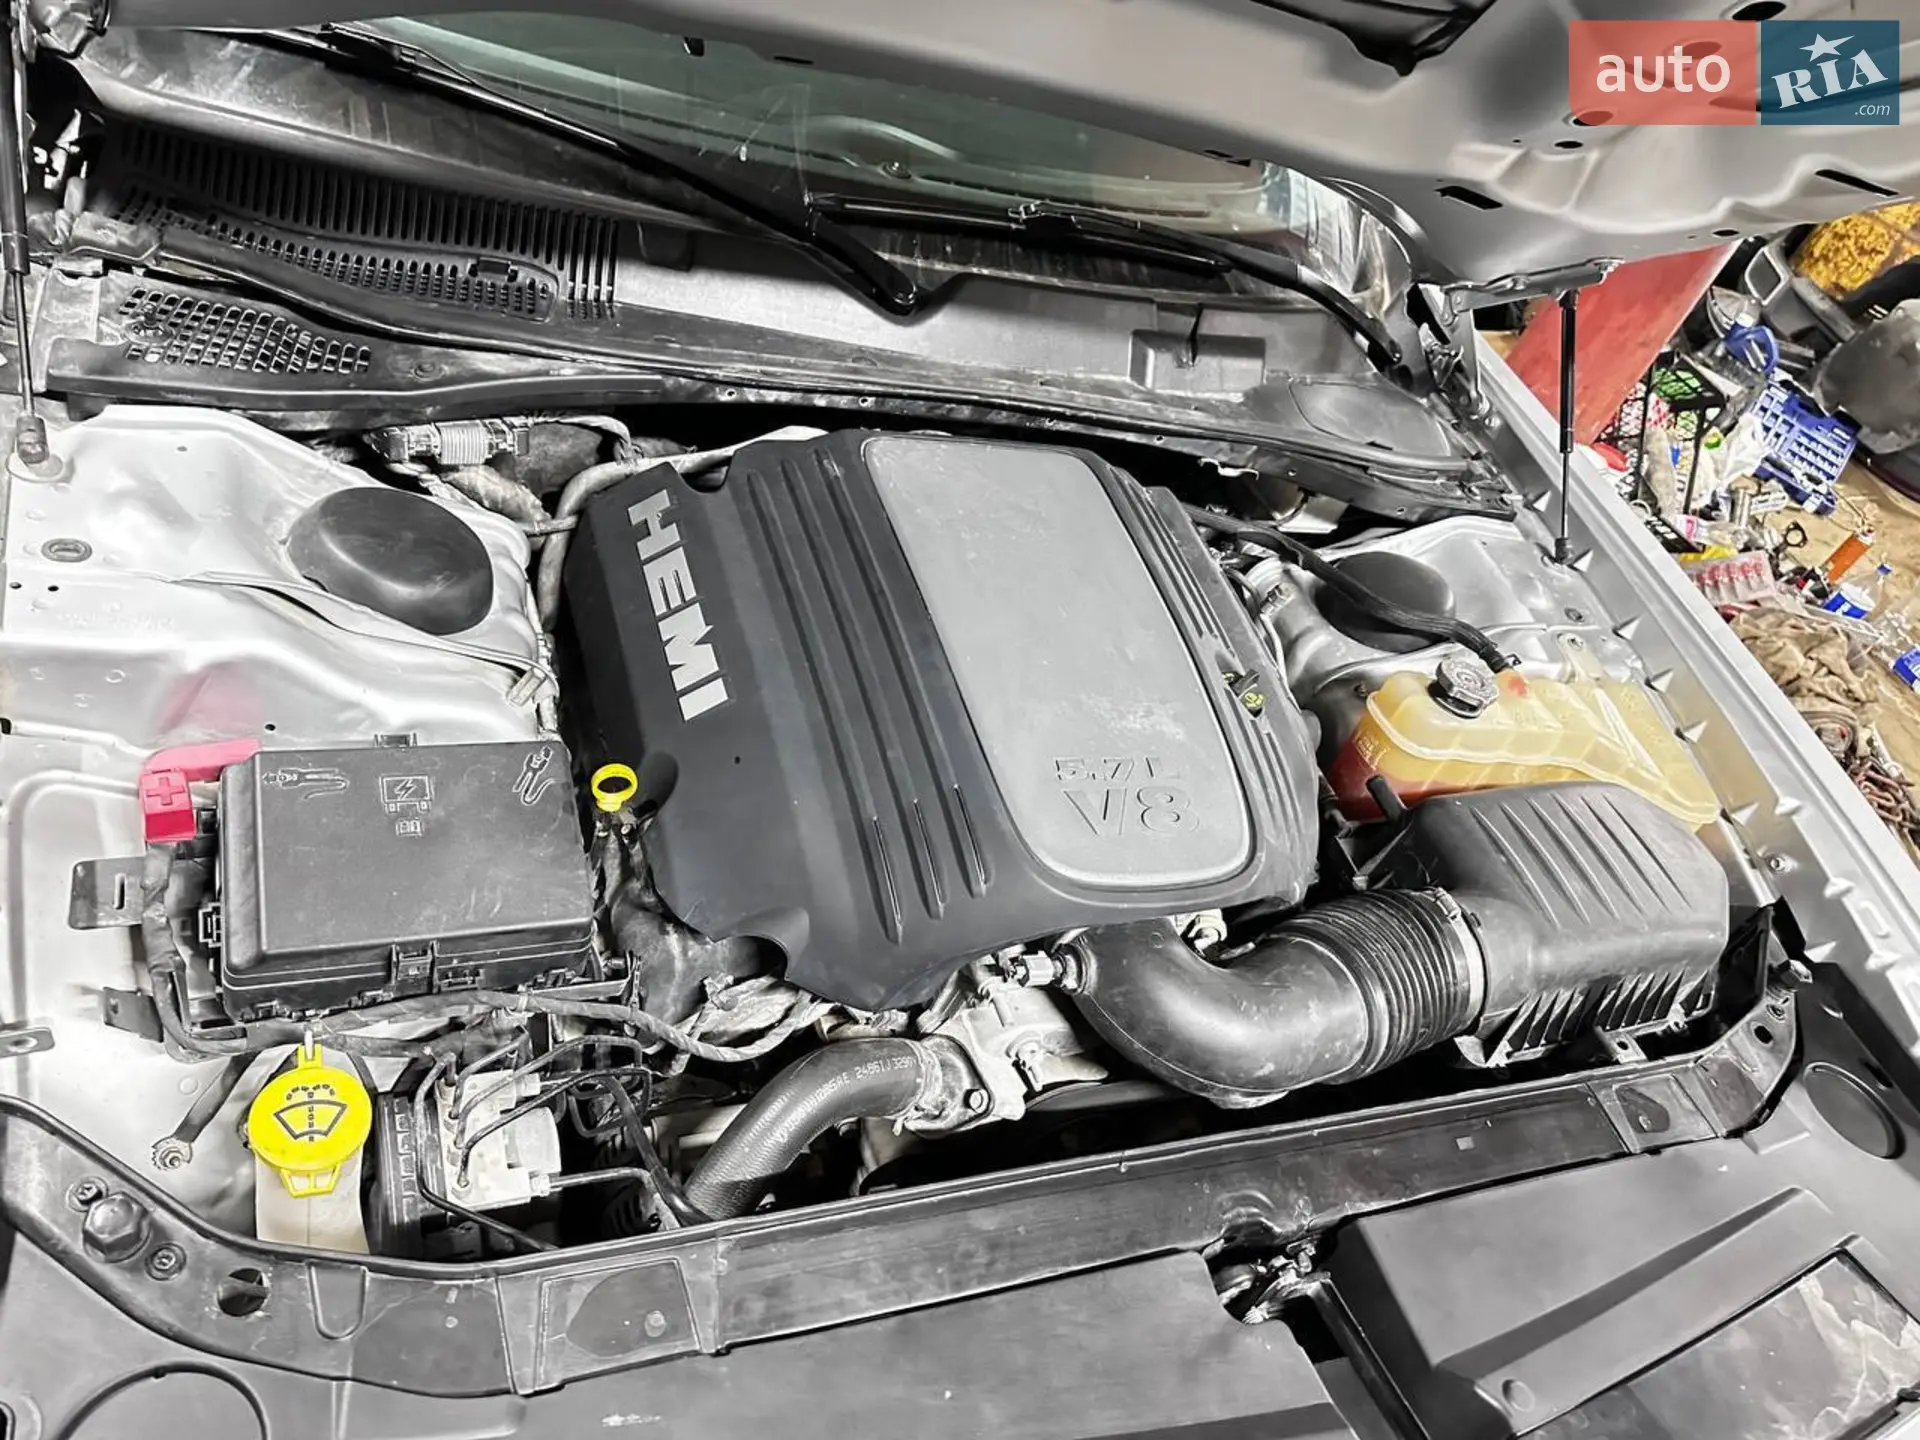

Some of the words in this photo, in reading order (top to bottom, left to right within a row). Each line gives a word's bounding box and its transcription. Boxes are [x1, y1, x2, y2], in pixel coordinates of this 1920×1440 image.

[627, 489, 729, 721] HEMI
[1053, 757, 1181, 781] 5.7L
[1060, 785, 1200, 836] V8
